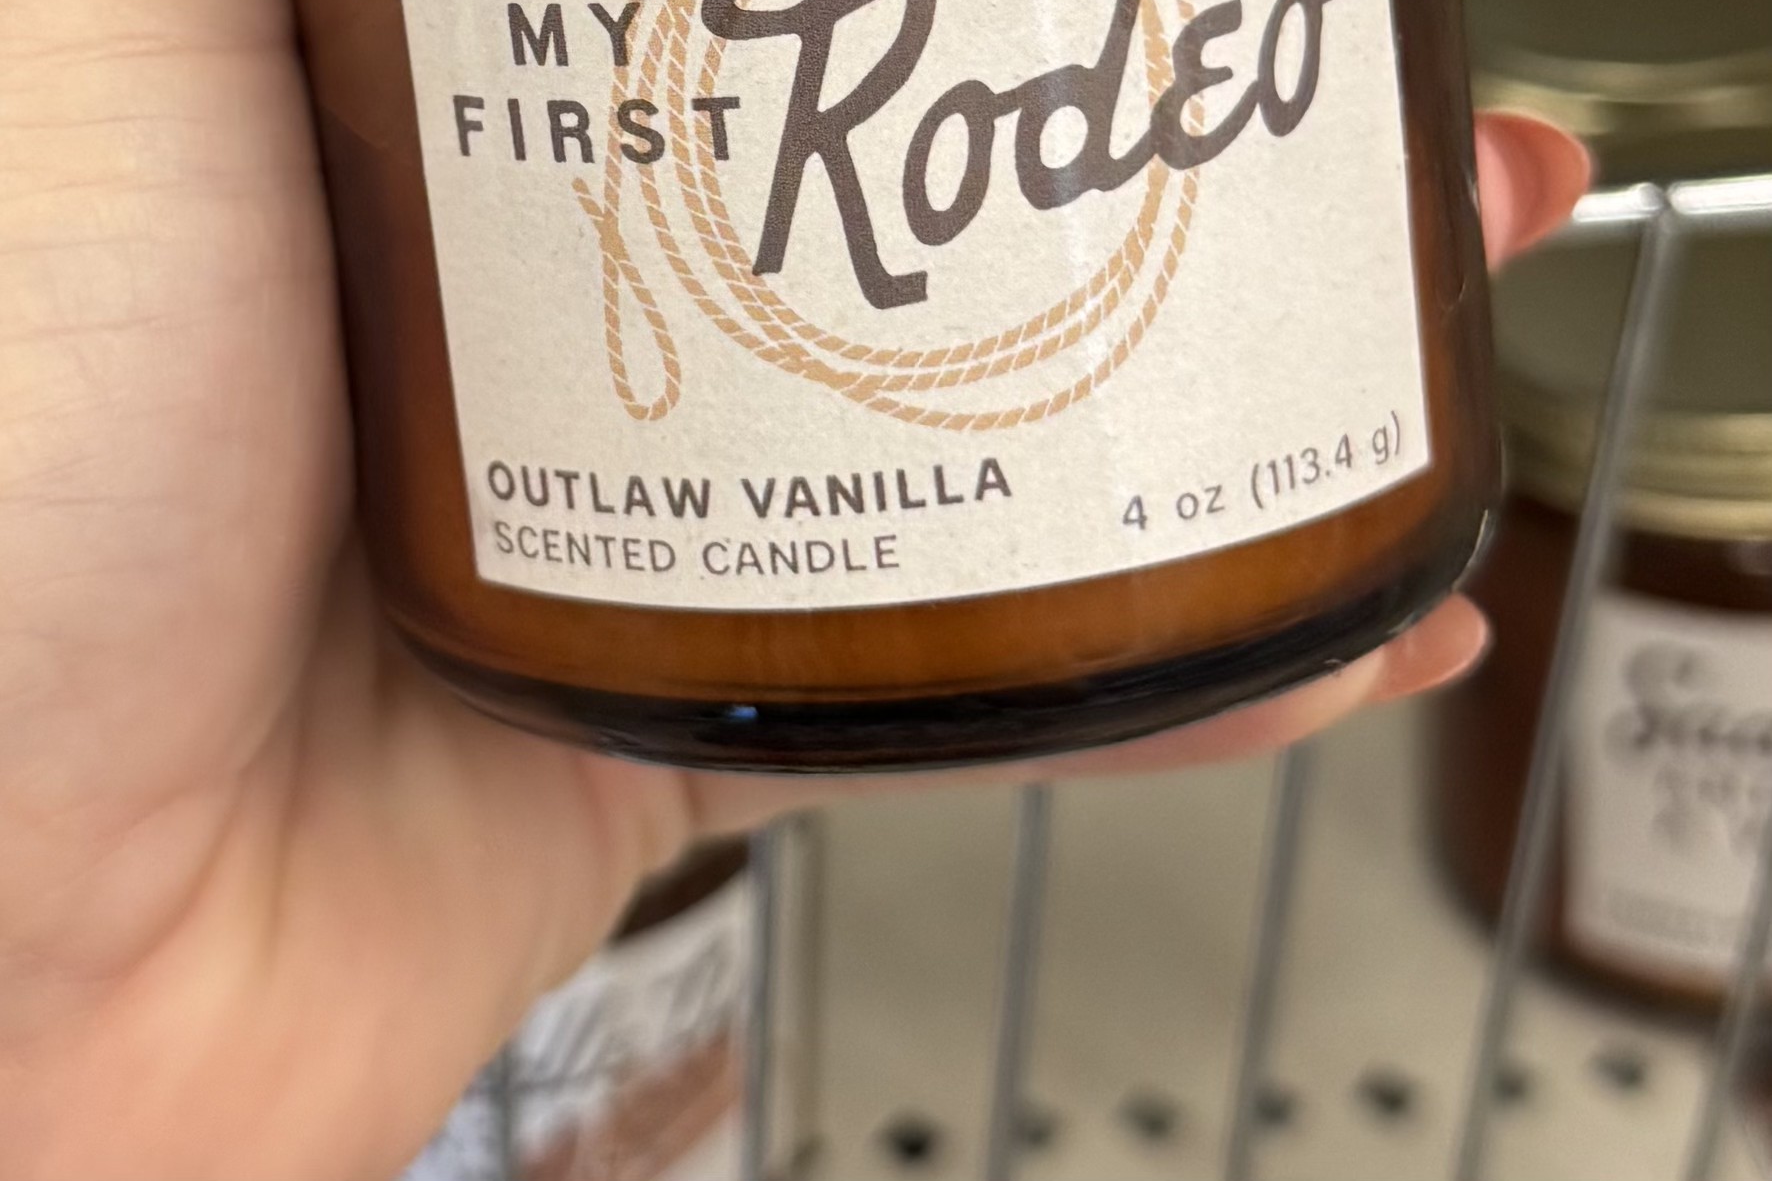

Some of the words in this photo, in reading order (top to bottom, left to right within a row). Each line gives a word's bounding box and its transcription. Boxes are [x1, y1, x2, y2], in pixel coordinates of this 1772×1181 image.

[507, 1, 641, 67] MY
[452, 94, 741, 165] FIRST
[487, 460, 712, 519] OUTLAW
[740, 458, 1013, 520] VANILLA
[1122, 495, 1148, 530] 4
[1175, 484, 1226, 520] oz
[1250, 433, 1354, 510] (113.4
[1372, 409, 1401, 465] g)
[493, 522, 677, 574] SCENTED
[702, 534, 901, 577] CANDLE
